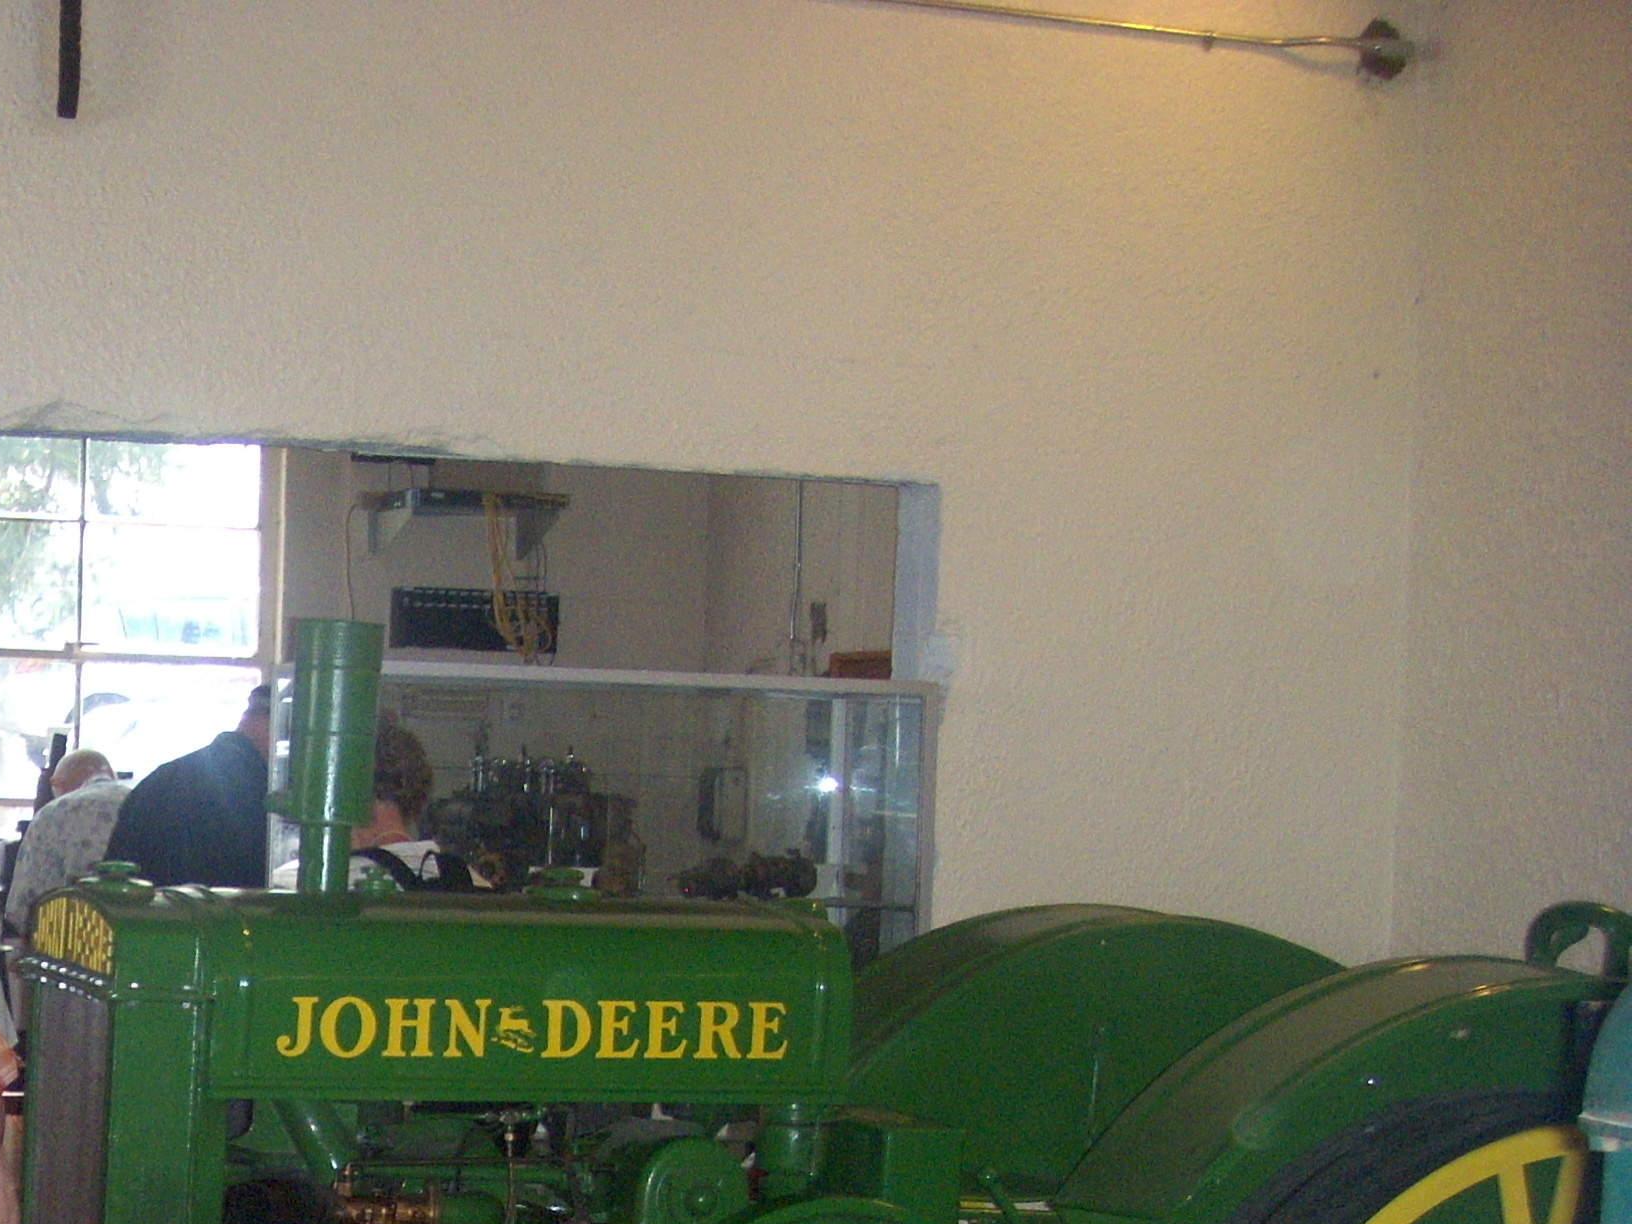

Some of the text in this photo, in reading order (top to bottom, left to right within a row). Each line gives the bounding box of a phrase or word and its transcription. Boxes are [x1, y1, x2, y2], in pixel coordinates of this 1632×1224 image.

[33, 897, 67, 958] JOHN
[276, 996, 789, 1060] JOHN DEERE
